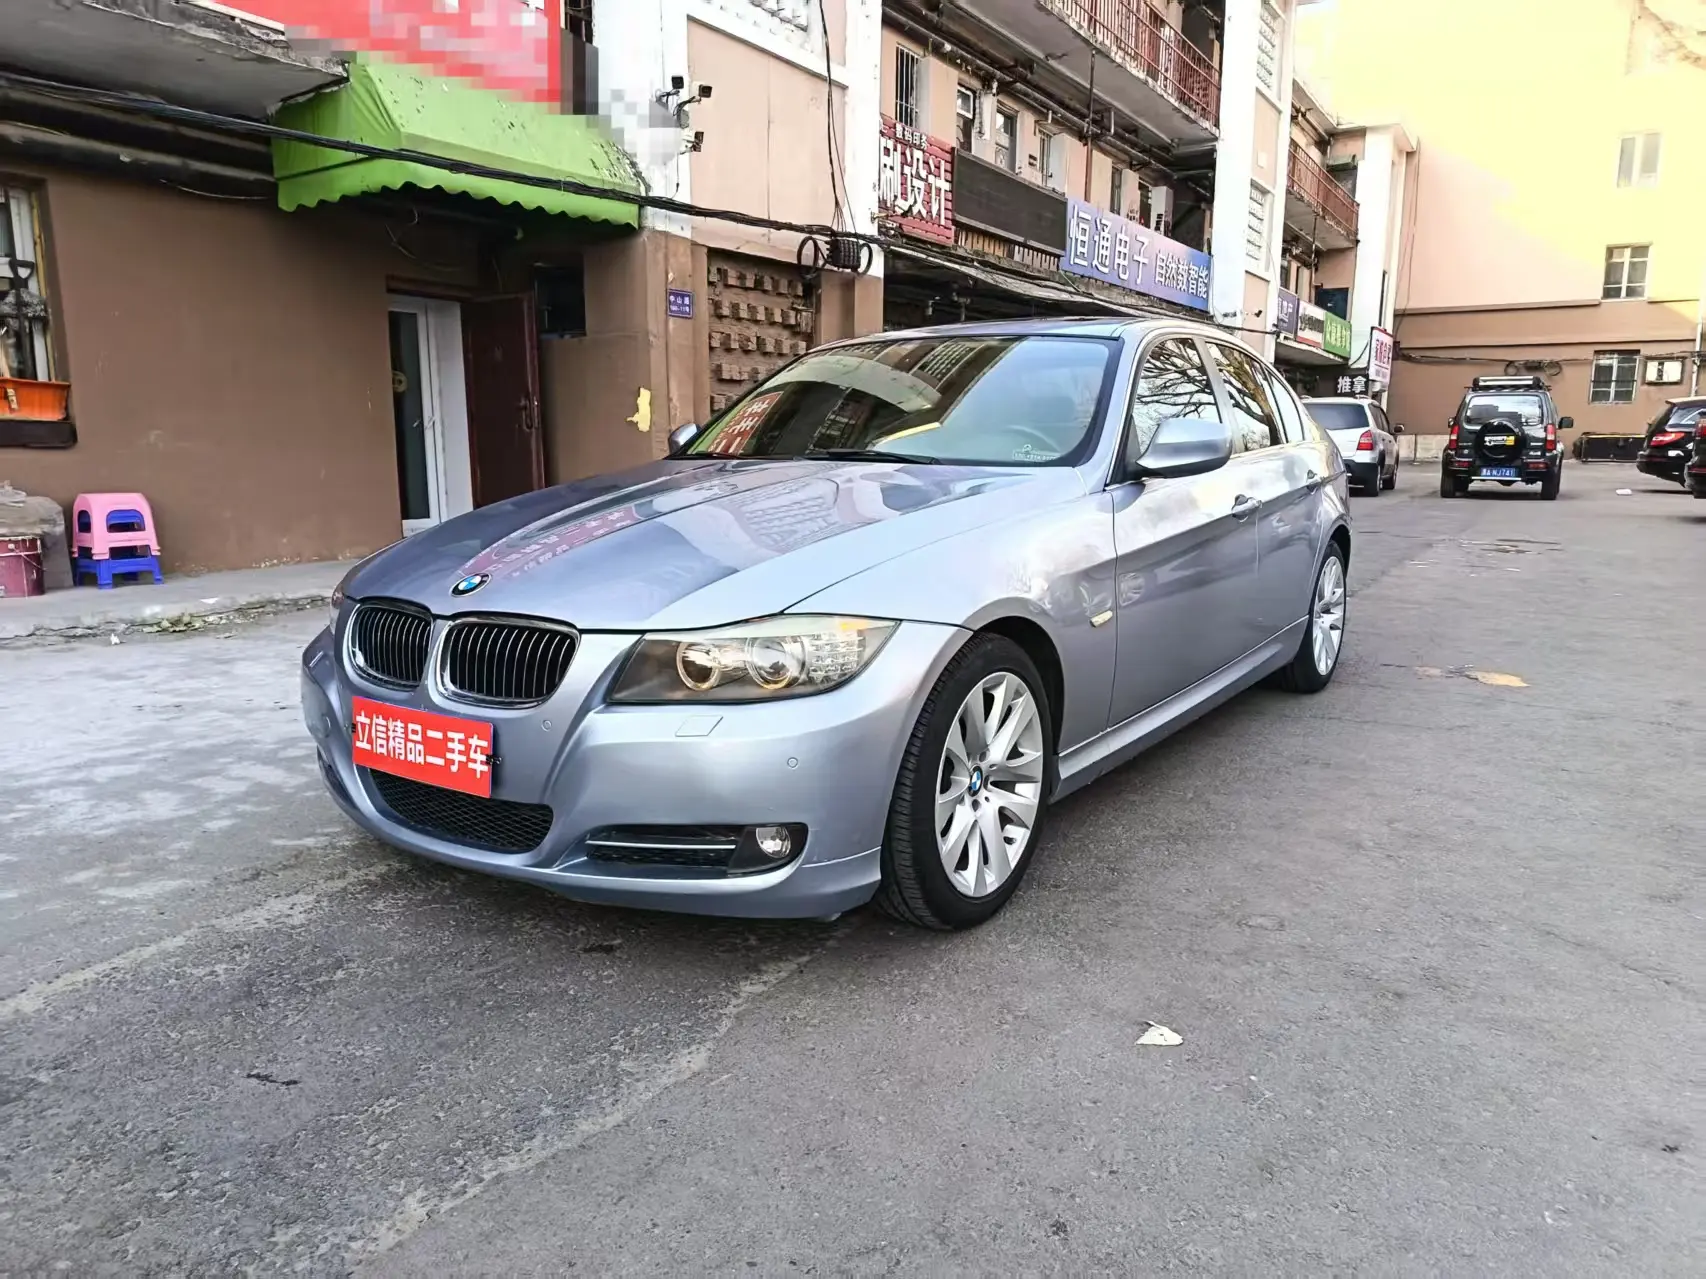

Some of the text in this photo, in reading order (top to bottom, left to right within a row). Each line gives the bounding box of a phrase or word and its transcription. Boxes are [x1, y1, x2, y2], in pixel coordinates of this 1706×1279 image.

[879, 136, 950, 226] 刷设计
[1069, 204, 1209, 299] 恒通电子 自然数智能
[1337, 376, 1367, 394] 推拿
[355, 710, 489, 779] 立信精品二手车
